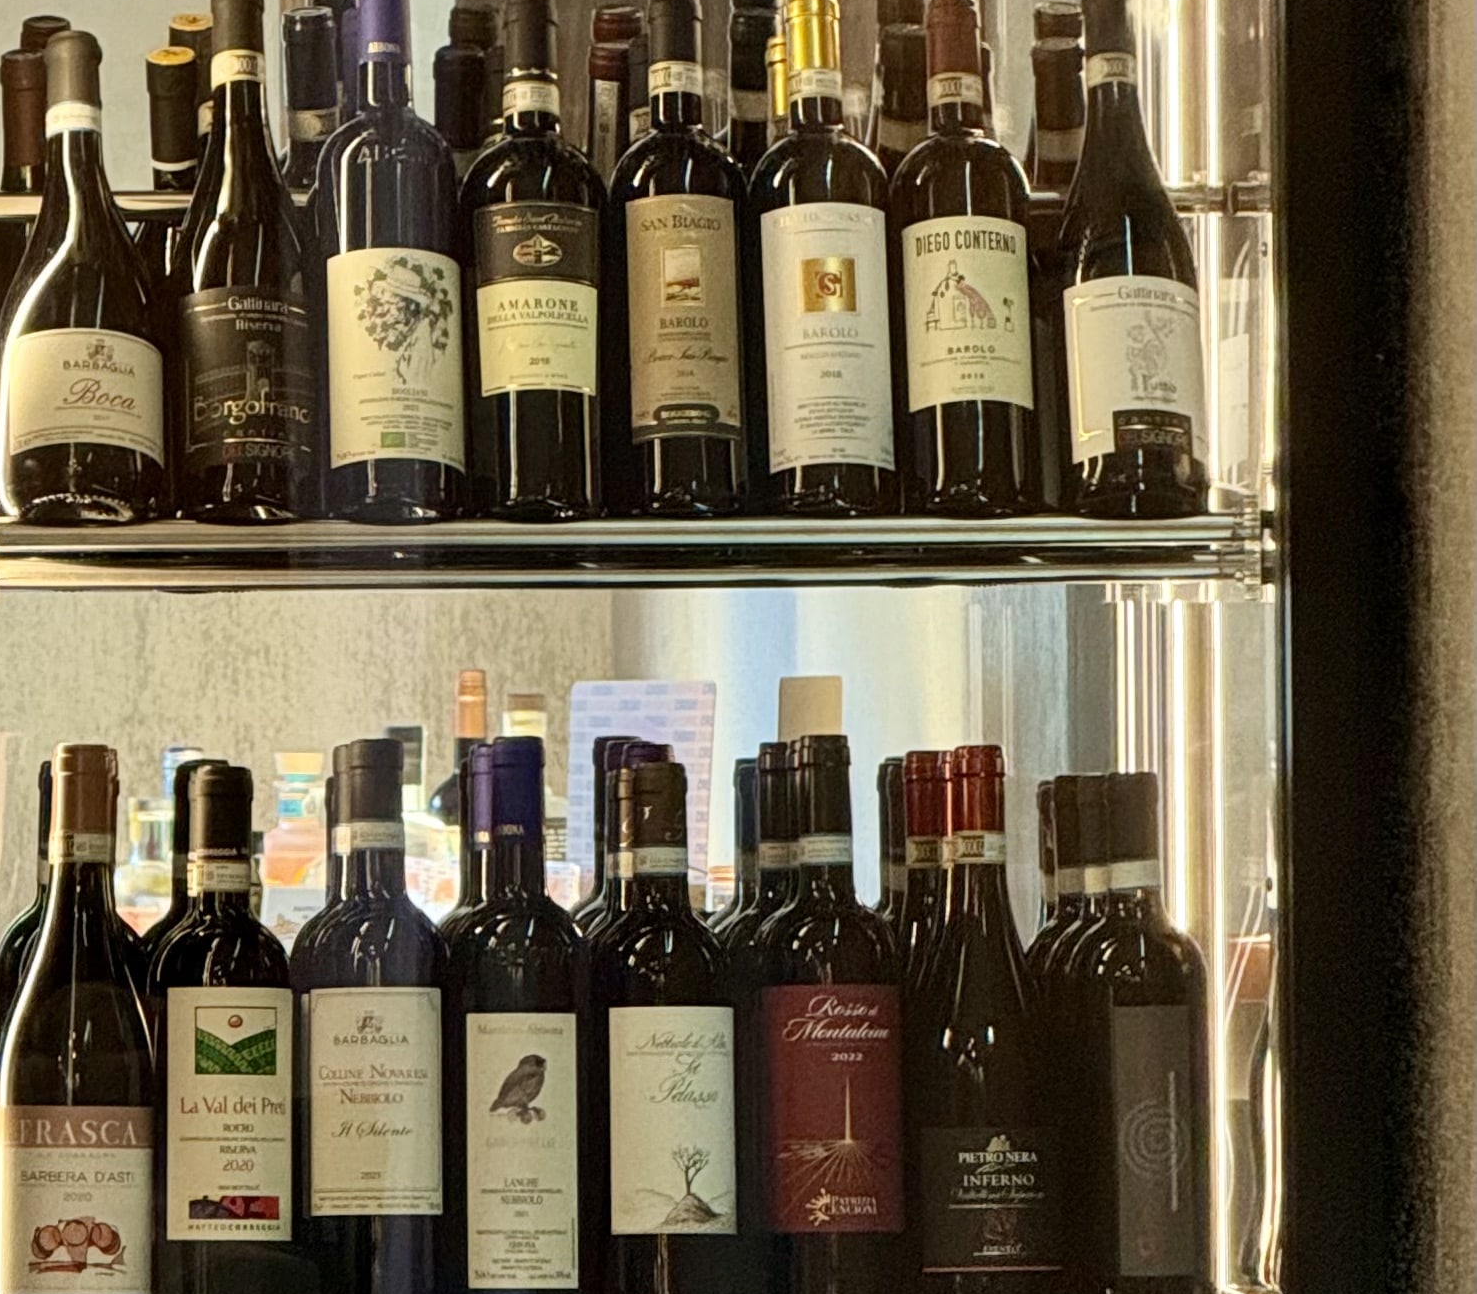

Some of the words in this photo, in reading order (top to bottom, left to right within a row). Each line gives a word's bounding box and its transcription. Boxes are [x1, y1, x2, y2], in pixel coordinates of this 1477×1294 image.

[641, 217, 668, 232] SAN
[671, 215, 721, 231] BIAGIO
[915, 231, 951, 257] DIEGO
[954, 229, 1017, 256] CONTERNO
[497, 297, 579, 313] AMARONE
[518, 310, 590, 324] VALPOLICELLA
[659, 316, 709, 330] BAROLO
[802, 327, 860, 340] BAROLO
[947, 345, 996, 355] BAROLO
[62, 359, 136, 378] BARBAGLIA
[63, 377, 137, 411] Boca
[333, 1035, 409, 1046] BARBAGLIA
[831, 1052, 863, 1062] 2022
[180, 1097, 199, 1115] La
[202, 1096, 228, 1115] Val
[233, 1095, 258, 1115] dei
[958, 1151, 1003, 1163] PIETRO
[1005, 1151, 1038, 1162] NERA
[222, 1159, 255, 1173] 2020
[20, 1170, 88, 1183] BARBERA
[963, 1173, 1035, 1187] INFERNO
